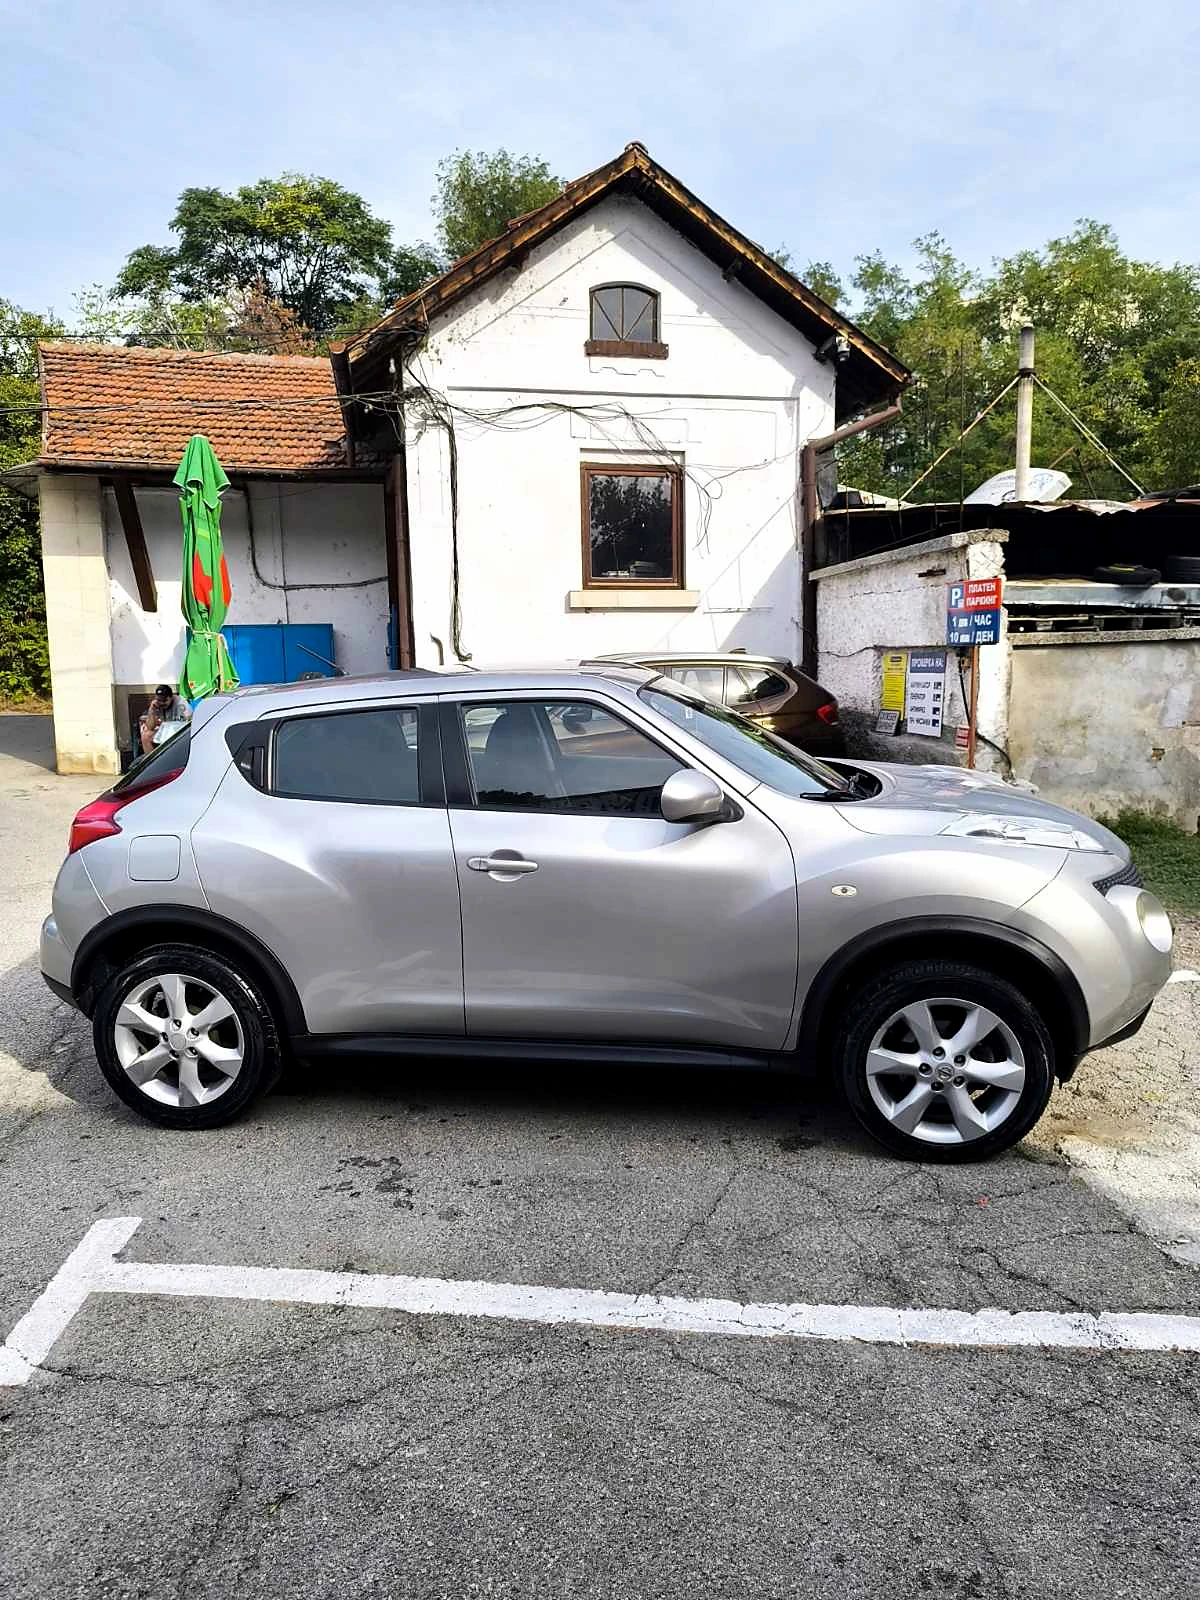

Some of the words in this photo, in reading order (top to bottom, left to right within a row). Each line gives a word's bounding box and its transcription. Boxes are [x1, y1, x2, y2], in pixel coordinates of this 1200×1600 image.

[969, 582, 996, 593] ПЛАТЕН
[951, 587, 961, 606] P
[966, 595, 998, 606] ПАРКИНГ
[952, 616, 957, 627] 1
[974, 614, 992, 626] ЧАС
[950, 632, 959, 643] 10
[975, 631, 994, 644] ДЕН
